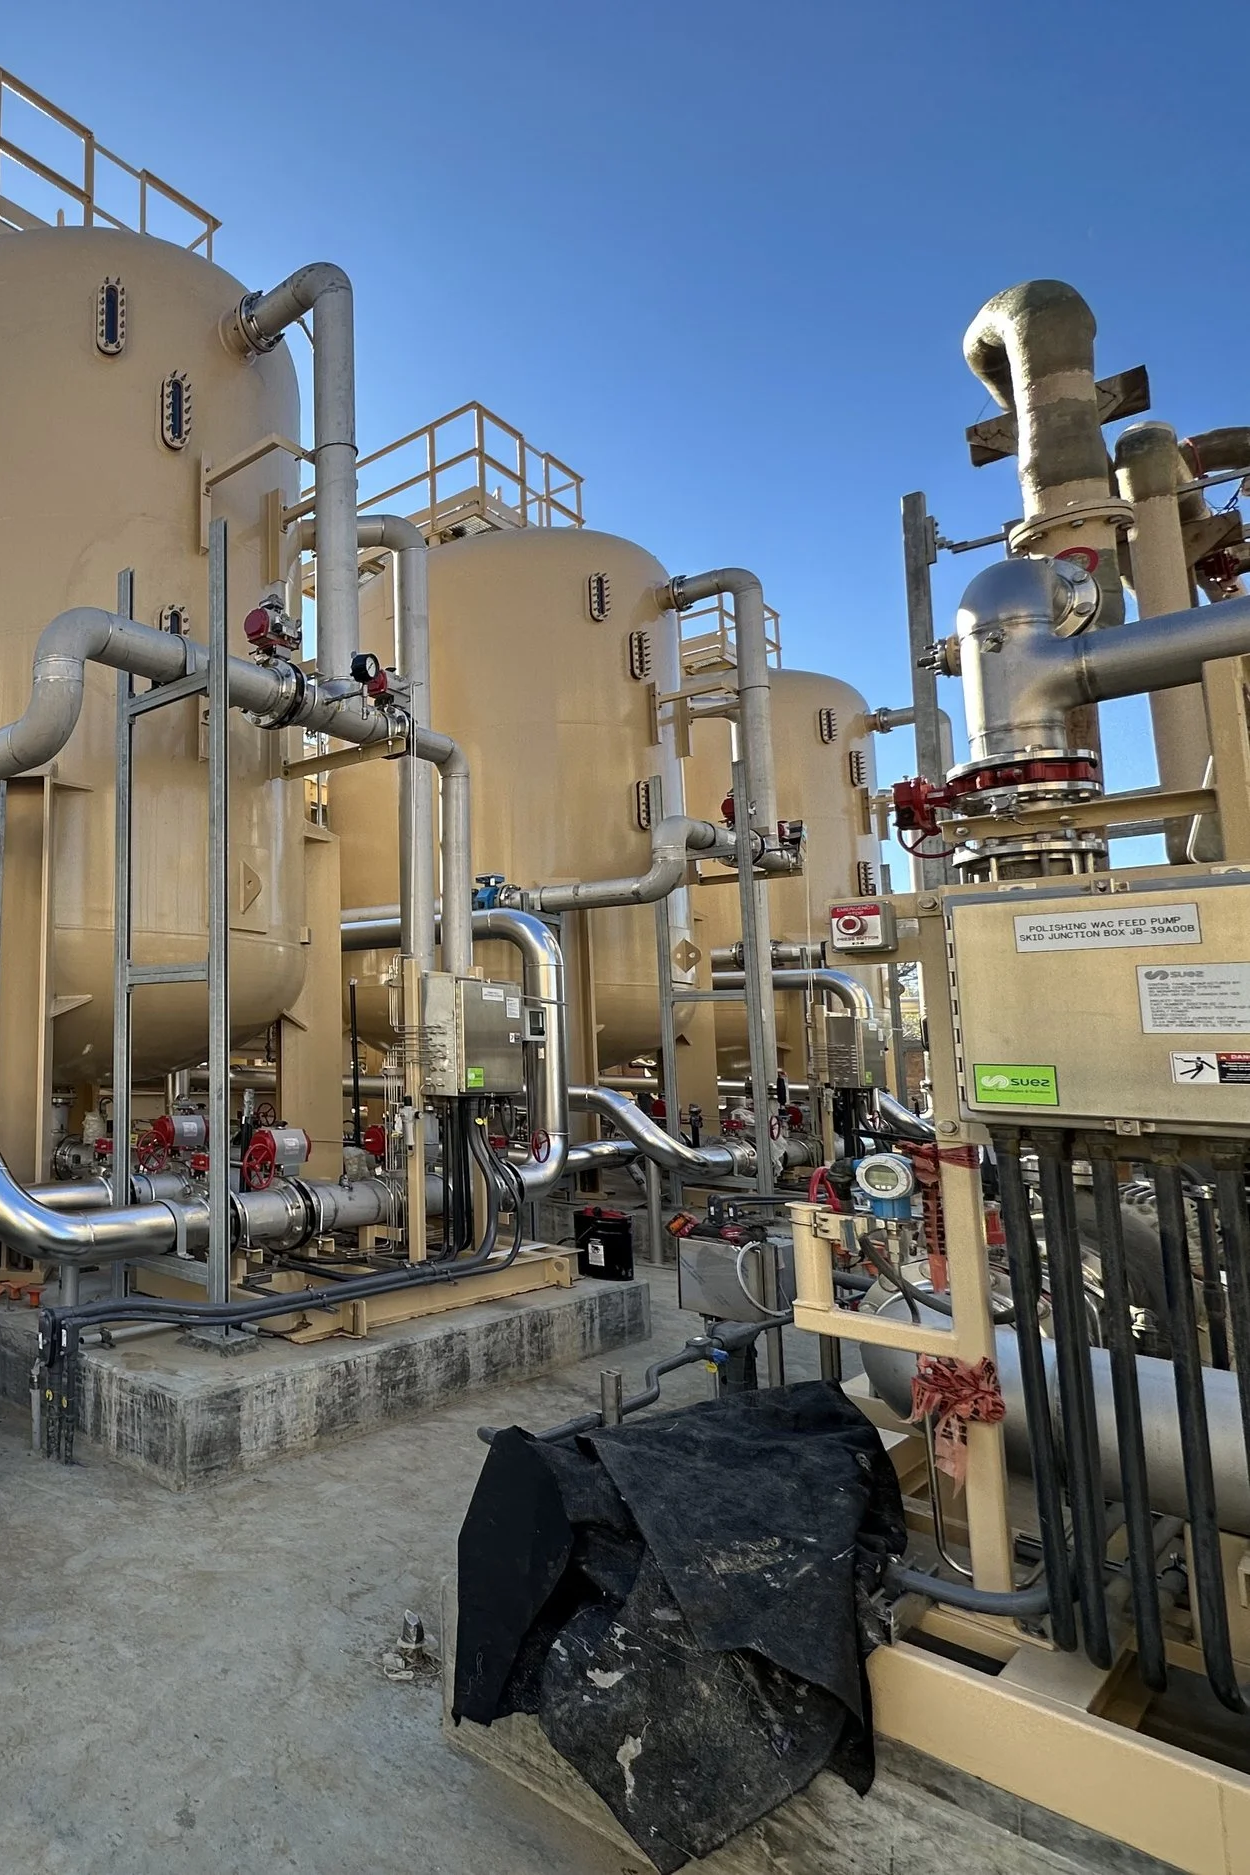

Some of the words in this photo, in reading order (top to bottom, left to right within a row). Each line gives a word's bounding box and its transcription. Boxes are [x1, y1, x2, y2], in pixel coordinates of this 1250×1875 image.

[836, 904, 875, 913] EMERGENCY
[1028, 922, 1087, 933] POLISHING
[1091, 920, 1115, 930] WAC
[1118, 918, 1147, 928] FEED
[1150, 916, 1182, 925] PUMP
[1019, 933, 1045, 942] SKID
[1048, 930, 1100, 940] JUNCTION
[1103, 929, 1126, 937] BOX
[1170, 970, 1205, 979] suez
[1010, 1078, 1051, 1087] suez
